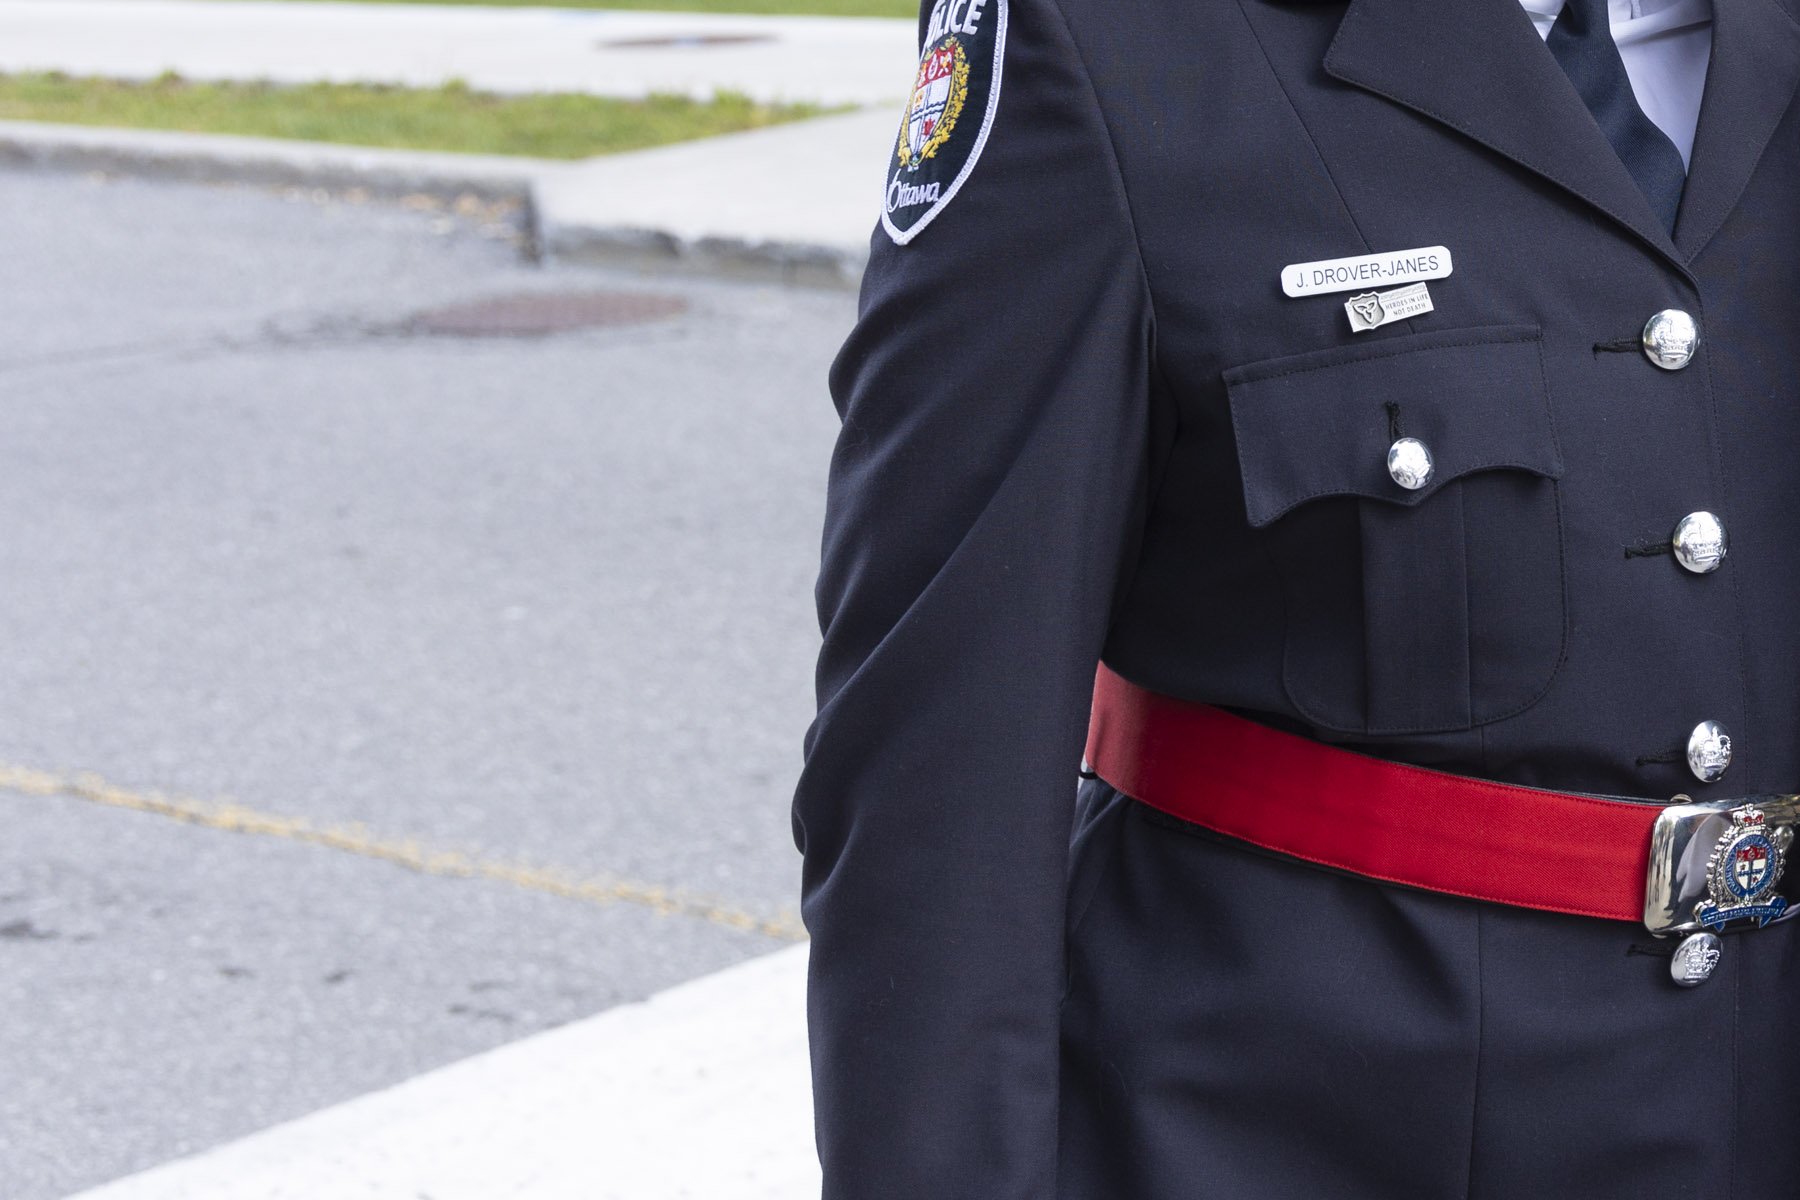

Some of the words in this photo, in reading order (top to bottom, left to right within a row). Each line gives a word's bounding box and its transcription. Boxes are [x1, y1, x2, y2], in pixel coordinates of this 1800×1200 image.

[888, 170, 941, 213] Ottawa
[1296, 272, 1309, 288] J.
[1313, 255, 1439, 287] DROVER-JANES
[1385, 299, 1409, 310] HEROES
[1417, 293, 1428, 302] LIFE
[1393, 308, 1406, 316] NOT
[1407, 303, 1427, 313] DEATH
